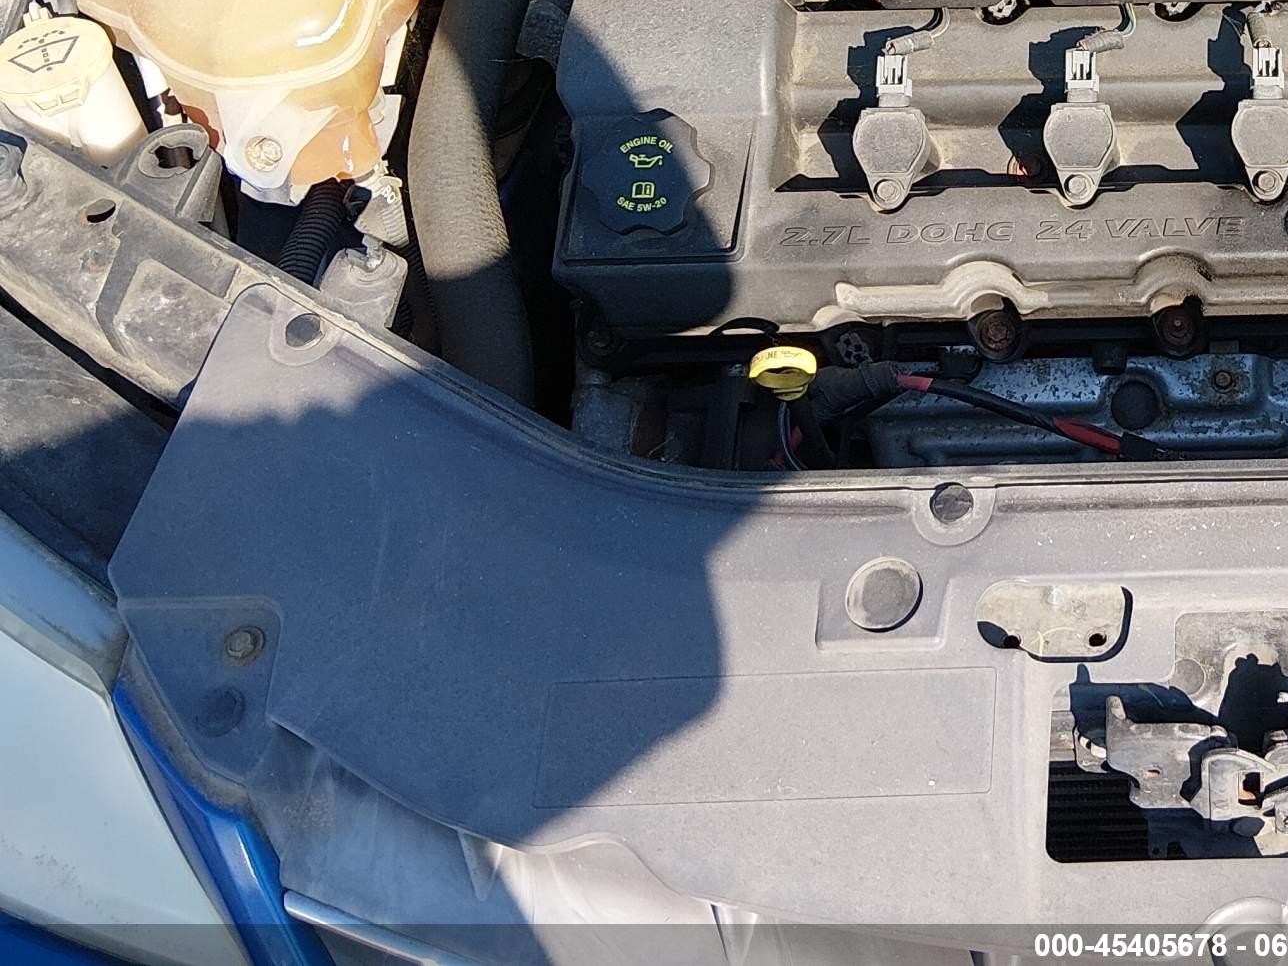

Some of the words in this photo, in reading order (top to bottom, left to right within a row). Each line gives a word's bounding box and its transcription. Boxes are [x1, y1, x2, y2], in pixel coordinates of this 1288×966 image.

[620, 136, 657, 153] ENGINE
[658, 139, 673, 153] OIL
[617, 196, 635, 211] SAE
[637, 197, 667, 212] 5W-20
[779, 226, 871, 246] 2.7L
[886, 221, 1017, 244] DOHC
[1035, 219, 1093, 240] 24
[1104, 217, 1246, 239] VALVE
